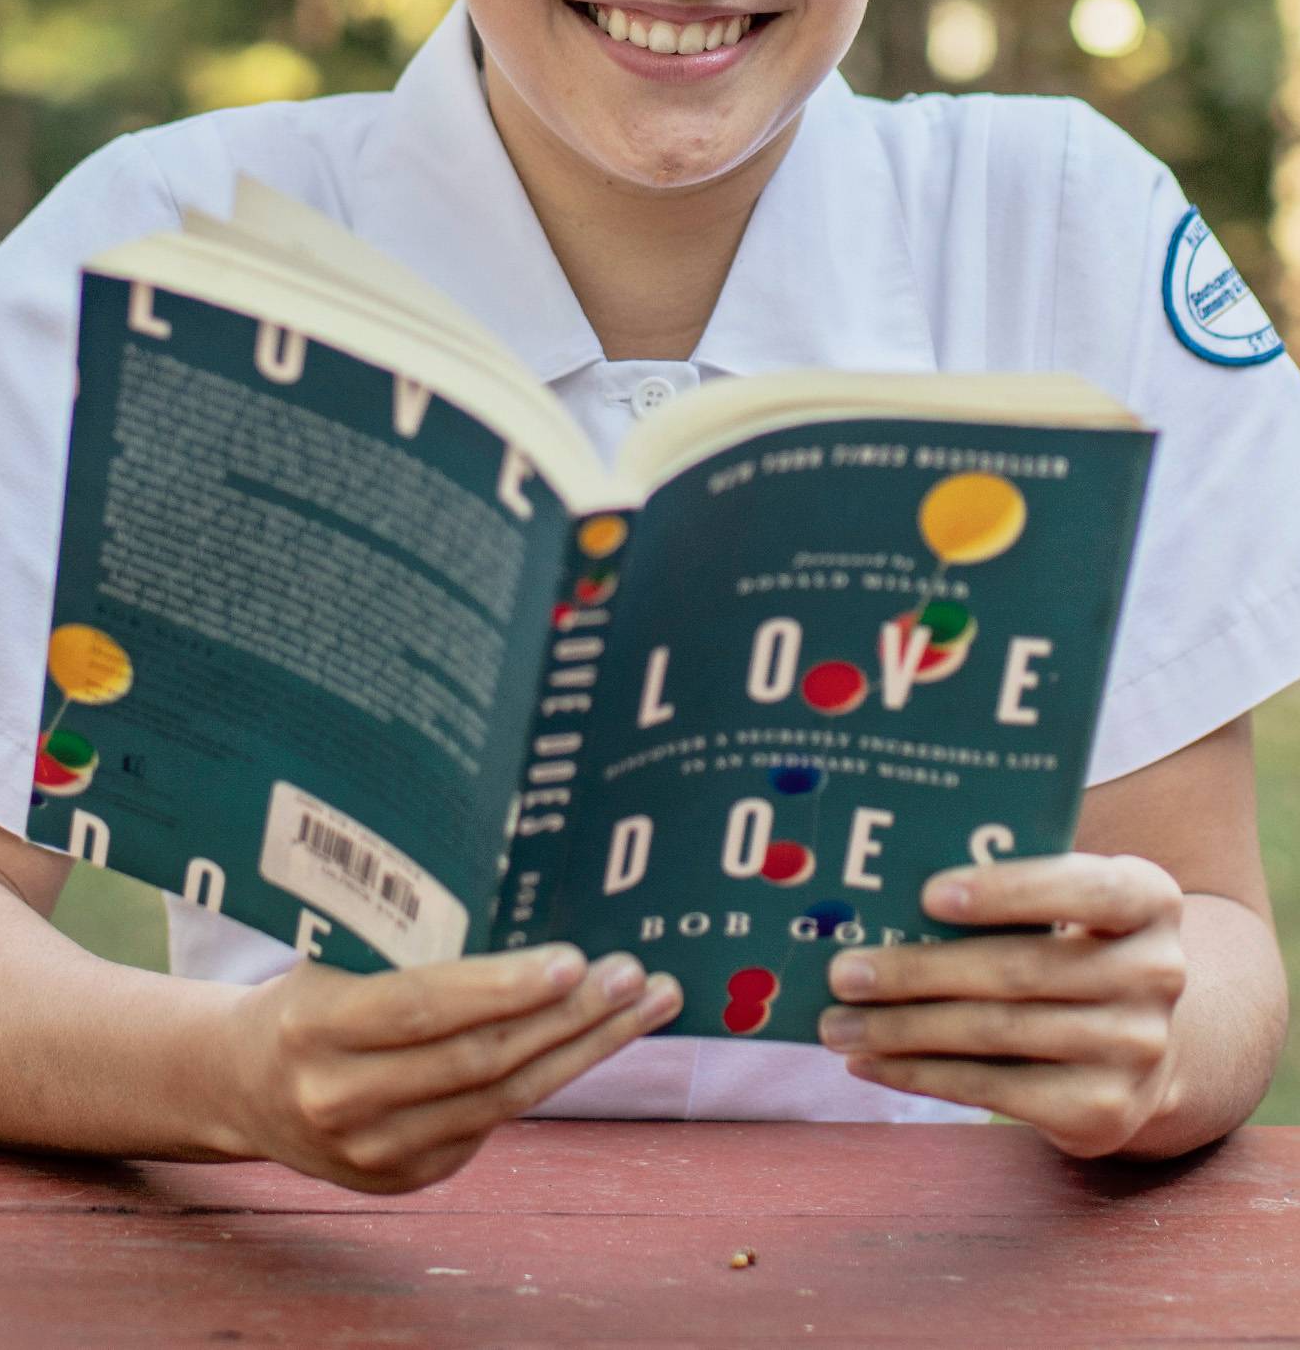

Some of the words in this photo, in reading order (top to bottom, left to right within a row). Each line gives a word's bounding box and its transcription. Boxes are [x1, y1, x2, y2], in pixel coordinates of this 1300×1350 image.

[761, 445, 824, 474] YORK
[831, 443, 908, 468] TIMES
[914, 445, 1069, 479] BESTSELLER
[736, 571, 849, 596] DONALD
[636, 616, 1053, 727] LOVE
[736, 727, 850, 749] SECRETLY
[857, 733, 999, 768] INCREDIBLE
[1006, 751, 1059, 772] LIFE
[518, 732, 582, 837] DOES
[715, 753, 743, 771] AN
[752, 751, 868, 775] ORDINARY
[876, 760, 961, 789] WORLD
[640, 911, 751, 942] BOB
